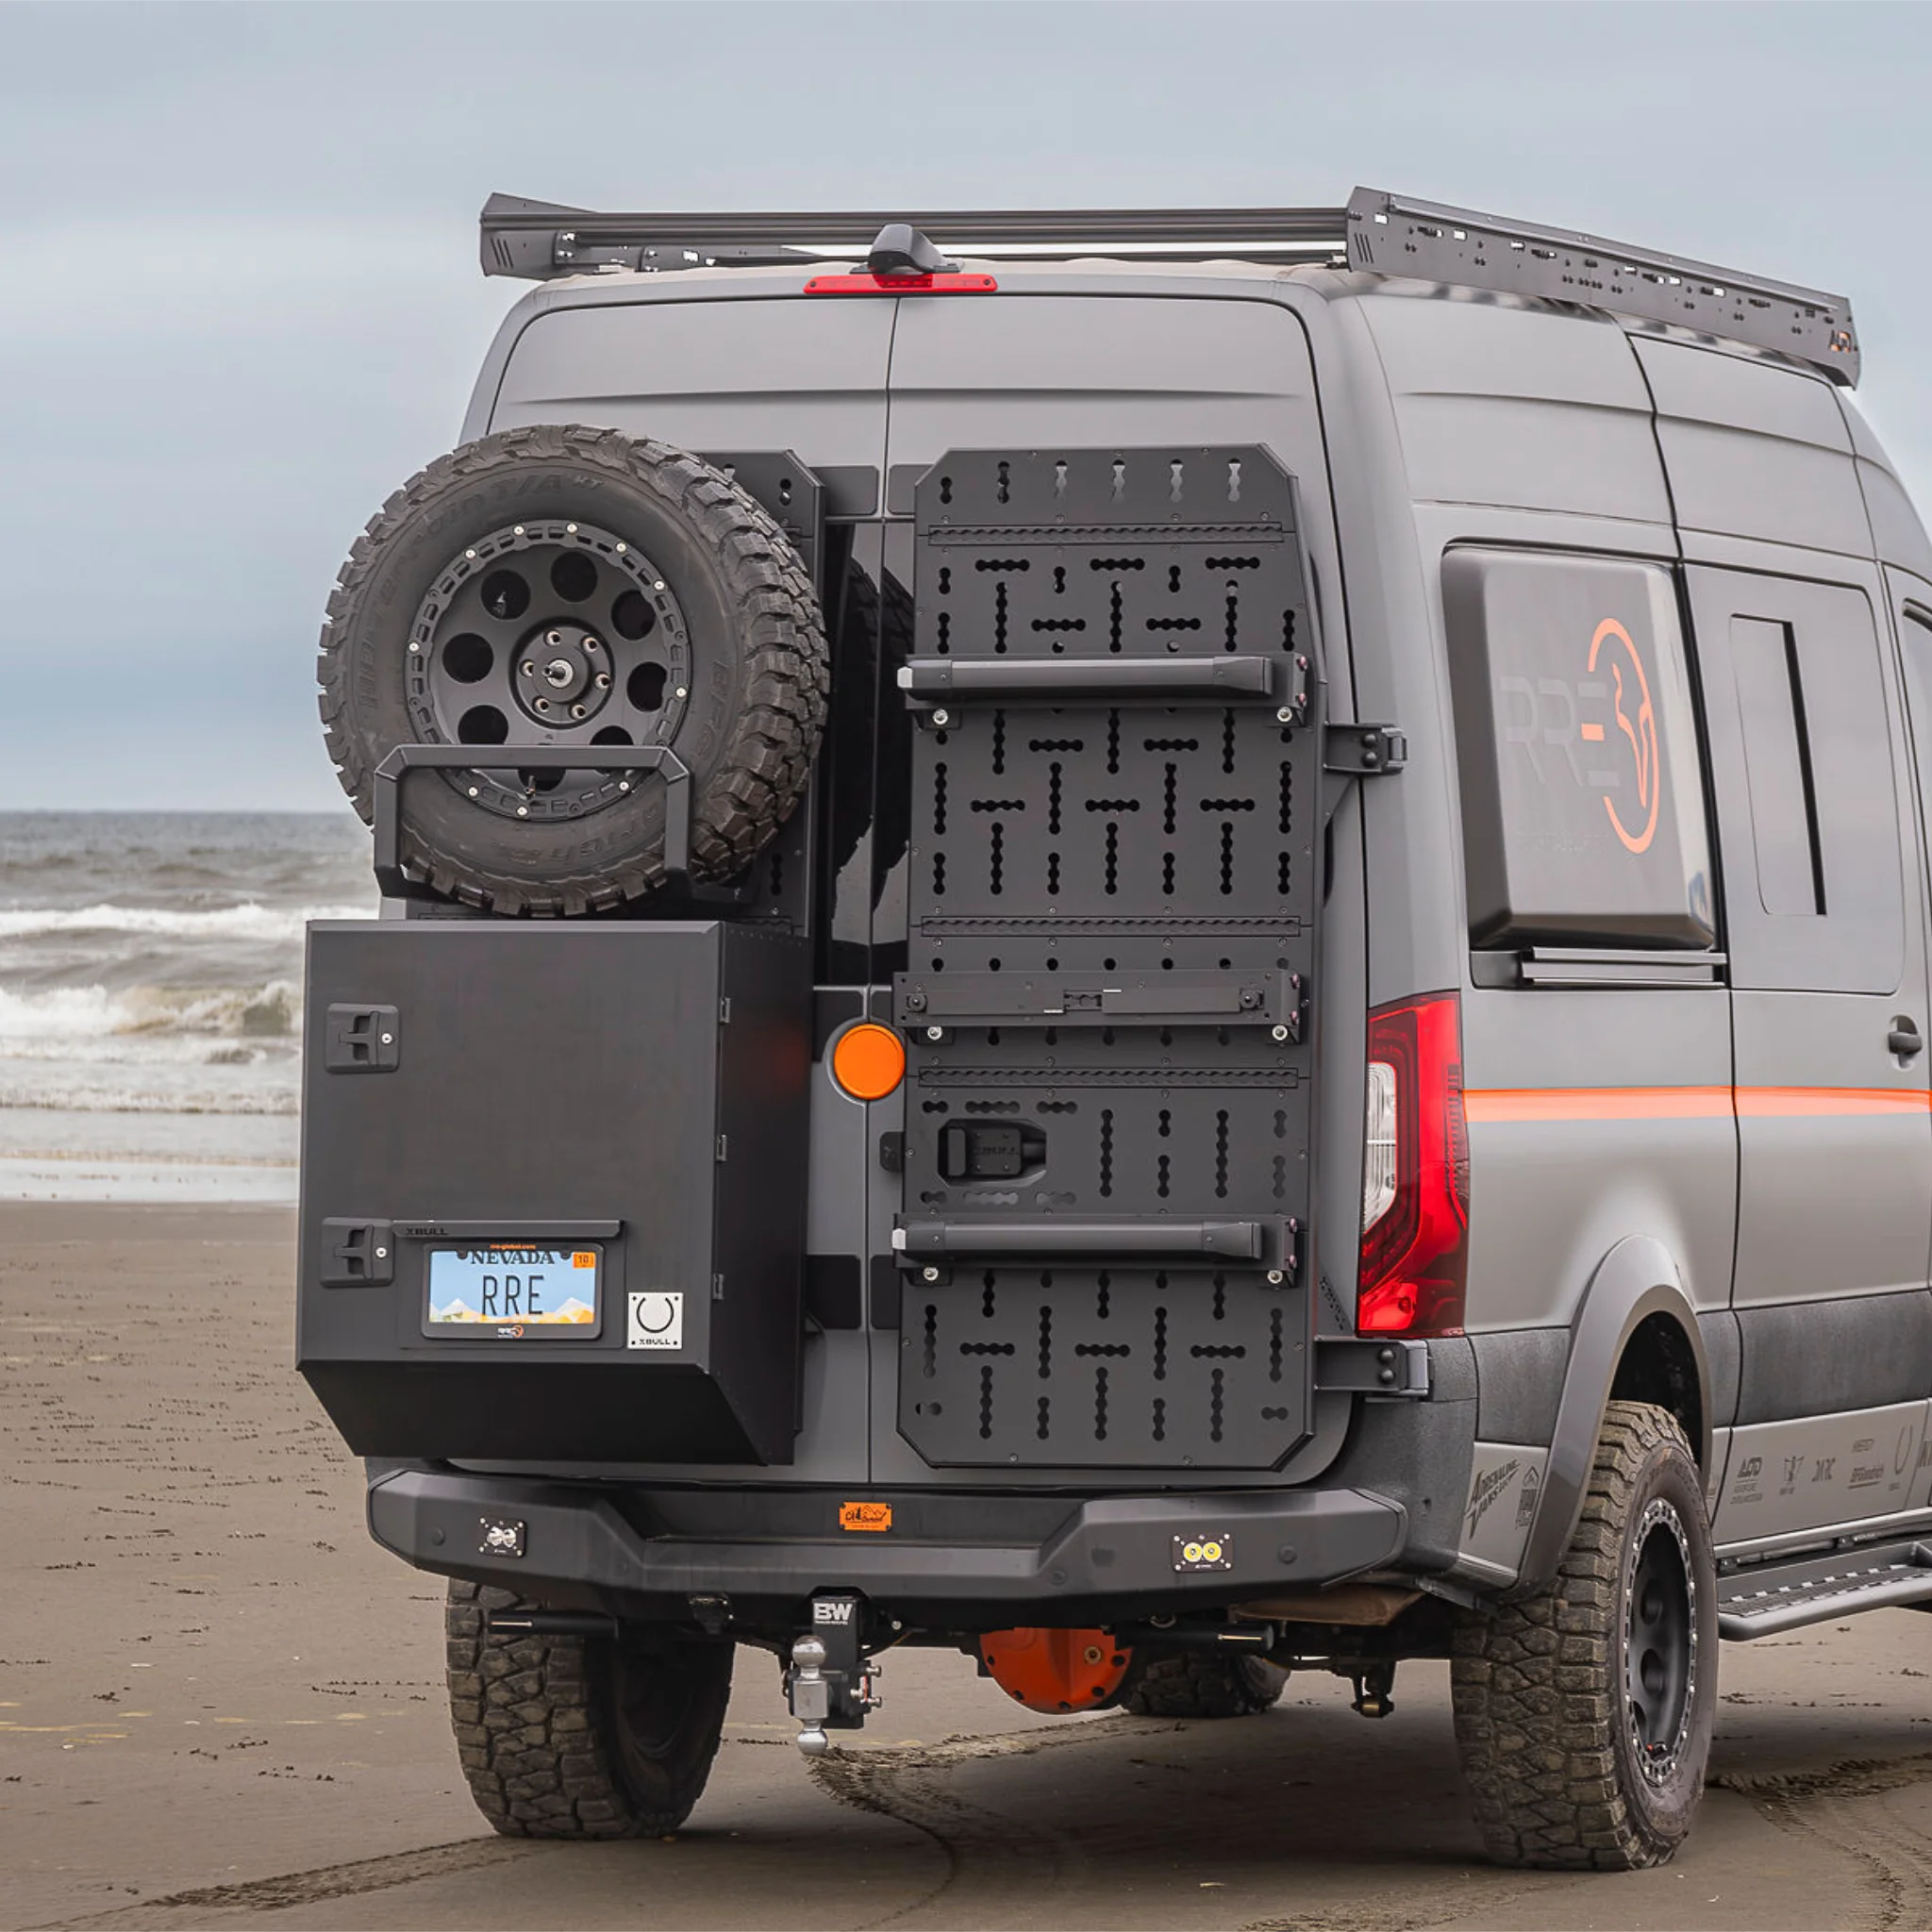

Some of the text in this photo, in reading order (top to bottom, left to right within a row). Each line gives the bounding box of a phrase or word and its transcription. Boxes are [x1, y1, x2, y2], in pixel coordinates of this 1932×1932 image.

[471, 1251, 555, 1264] NEVADA
[578, 1254, 590, 1264] 10
[482, 1274, 544, 1315] RRE
